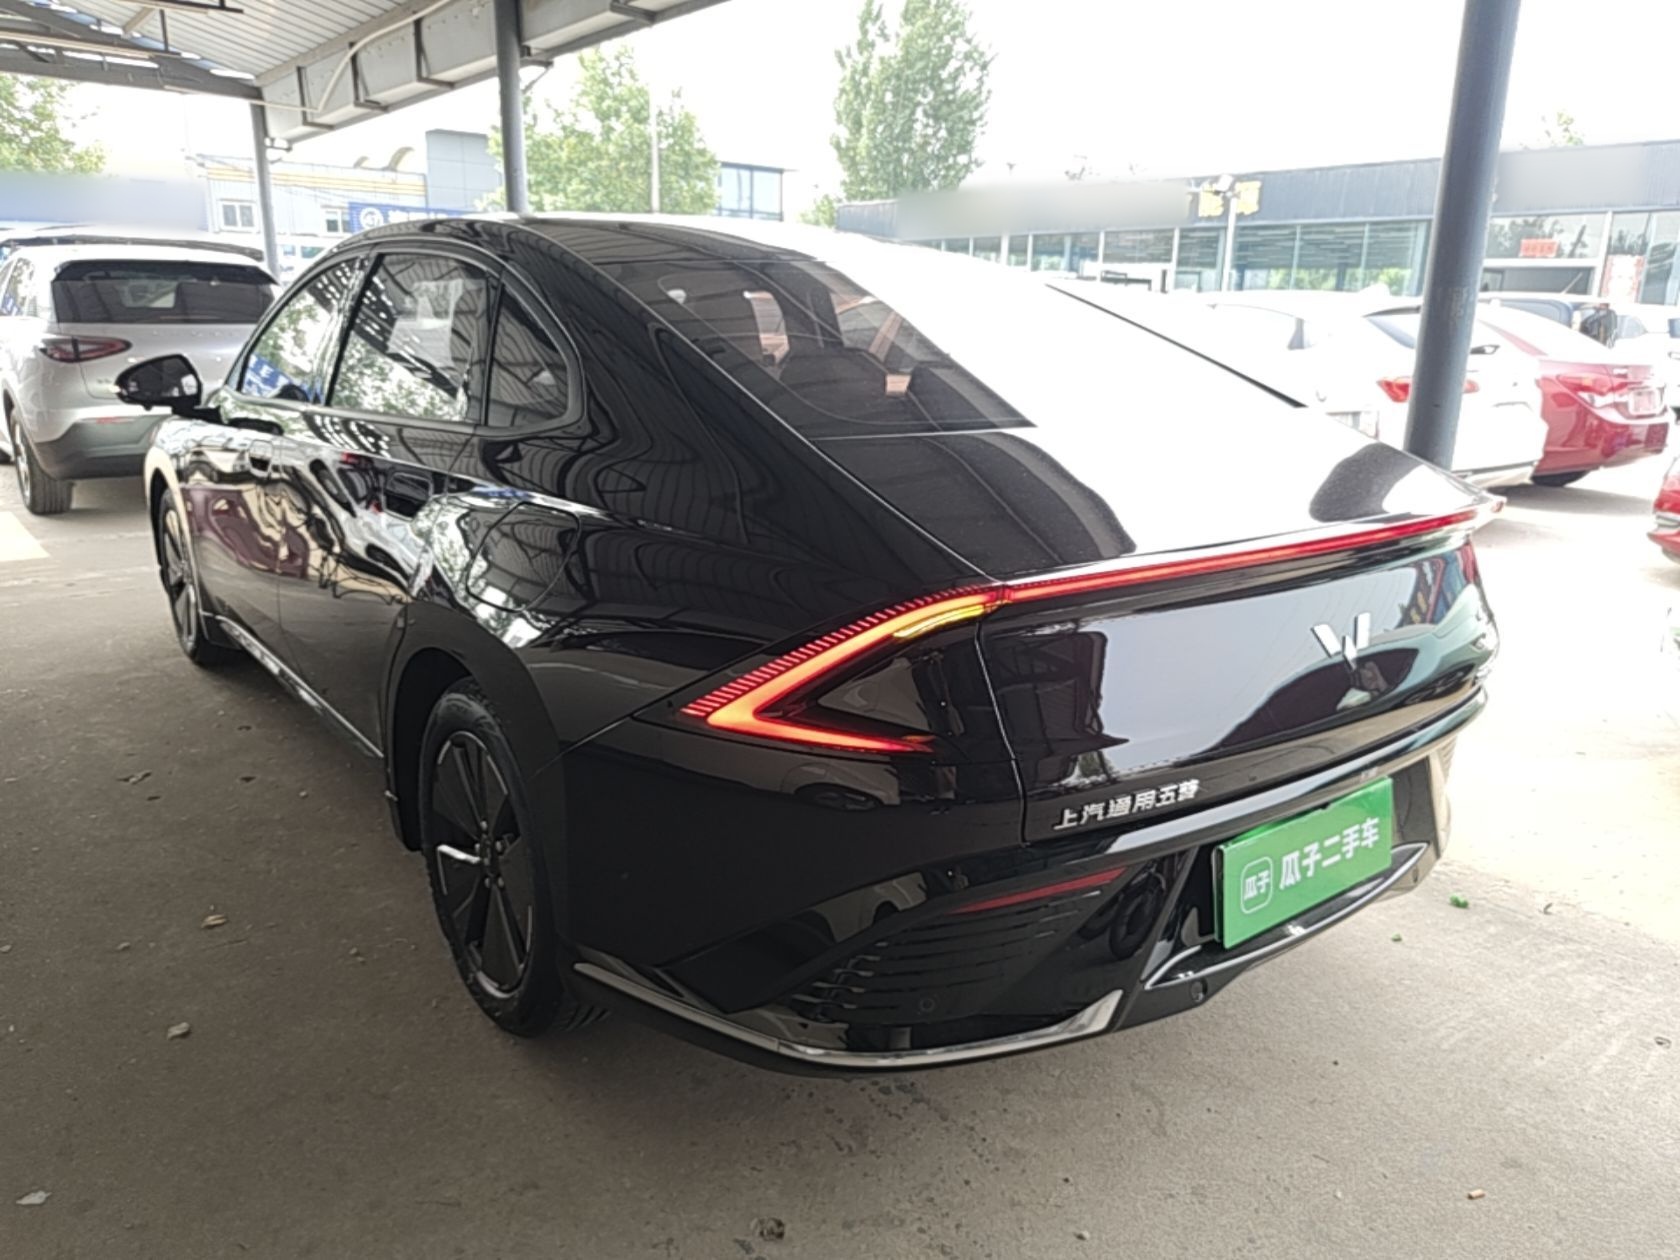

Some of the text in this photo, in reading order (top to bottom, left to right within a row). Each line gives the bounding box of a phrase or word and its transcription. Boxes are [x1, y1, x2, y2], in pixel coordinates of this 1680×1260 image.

[1279, 817, 1379, 890] 瓜子二手车
[1244, 869, 1270, 900] 瓜子
